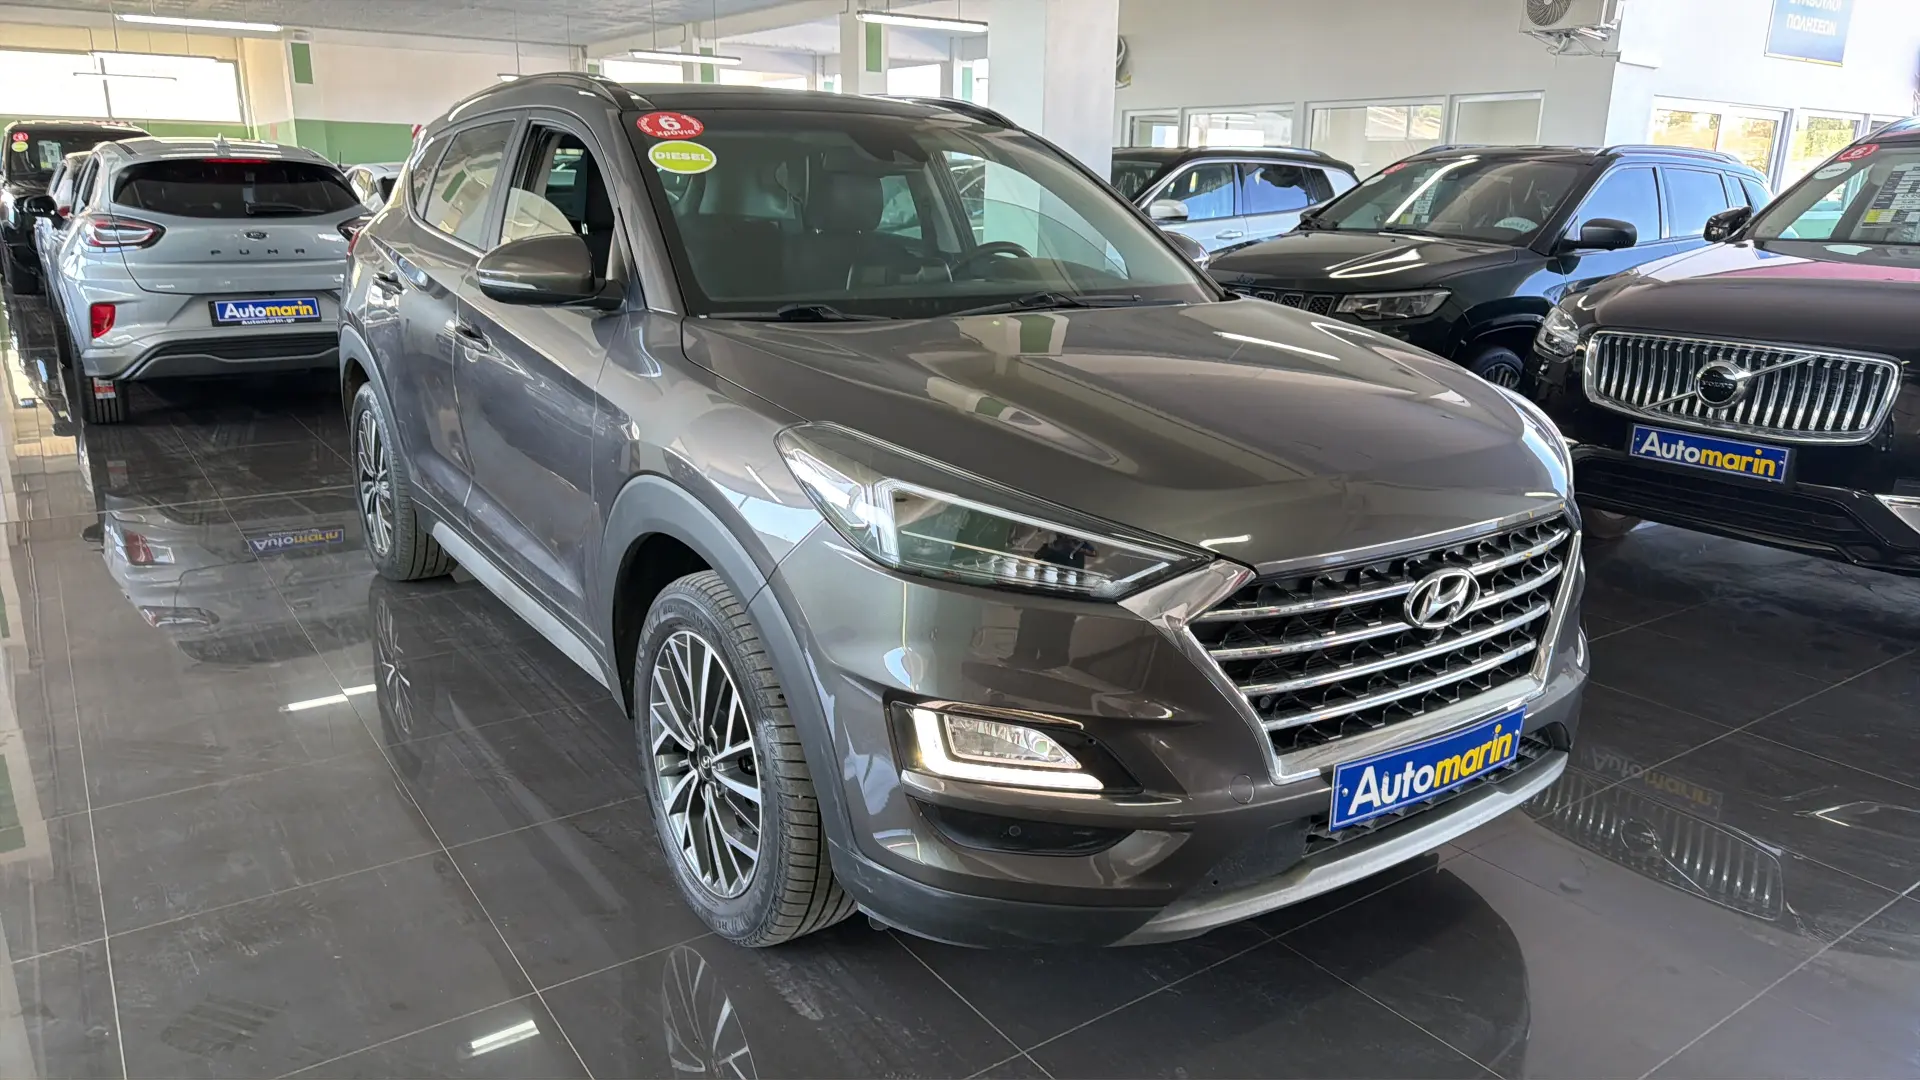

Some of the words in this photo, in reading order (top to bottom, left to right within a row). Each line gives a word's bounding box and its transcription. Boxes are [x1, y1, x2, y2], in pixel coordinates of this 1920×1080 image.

[658, 116, 681, 130] 6
[654, 151, 711, 162] DIESEL
[210, 248, 306, 256] PUMA
[223, 301, 314, 319] Automarin
[1639, 431, 1777, 477] Automarin
[1347, 723, 1513, 816] Automarin
